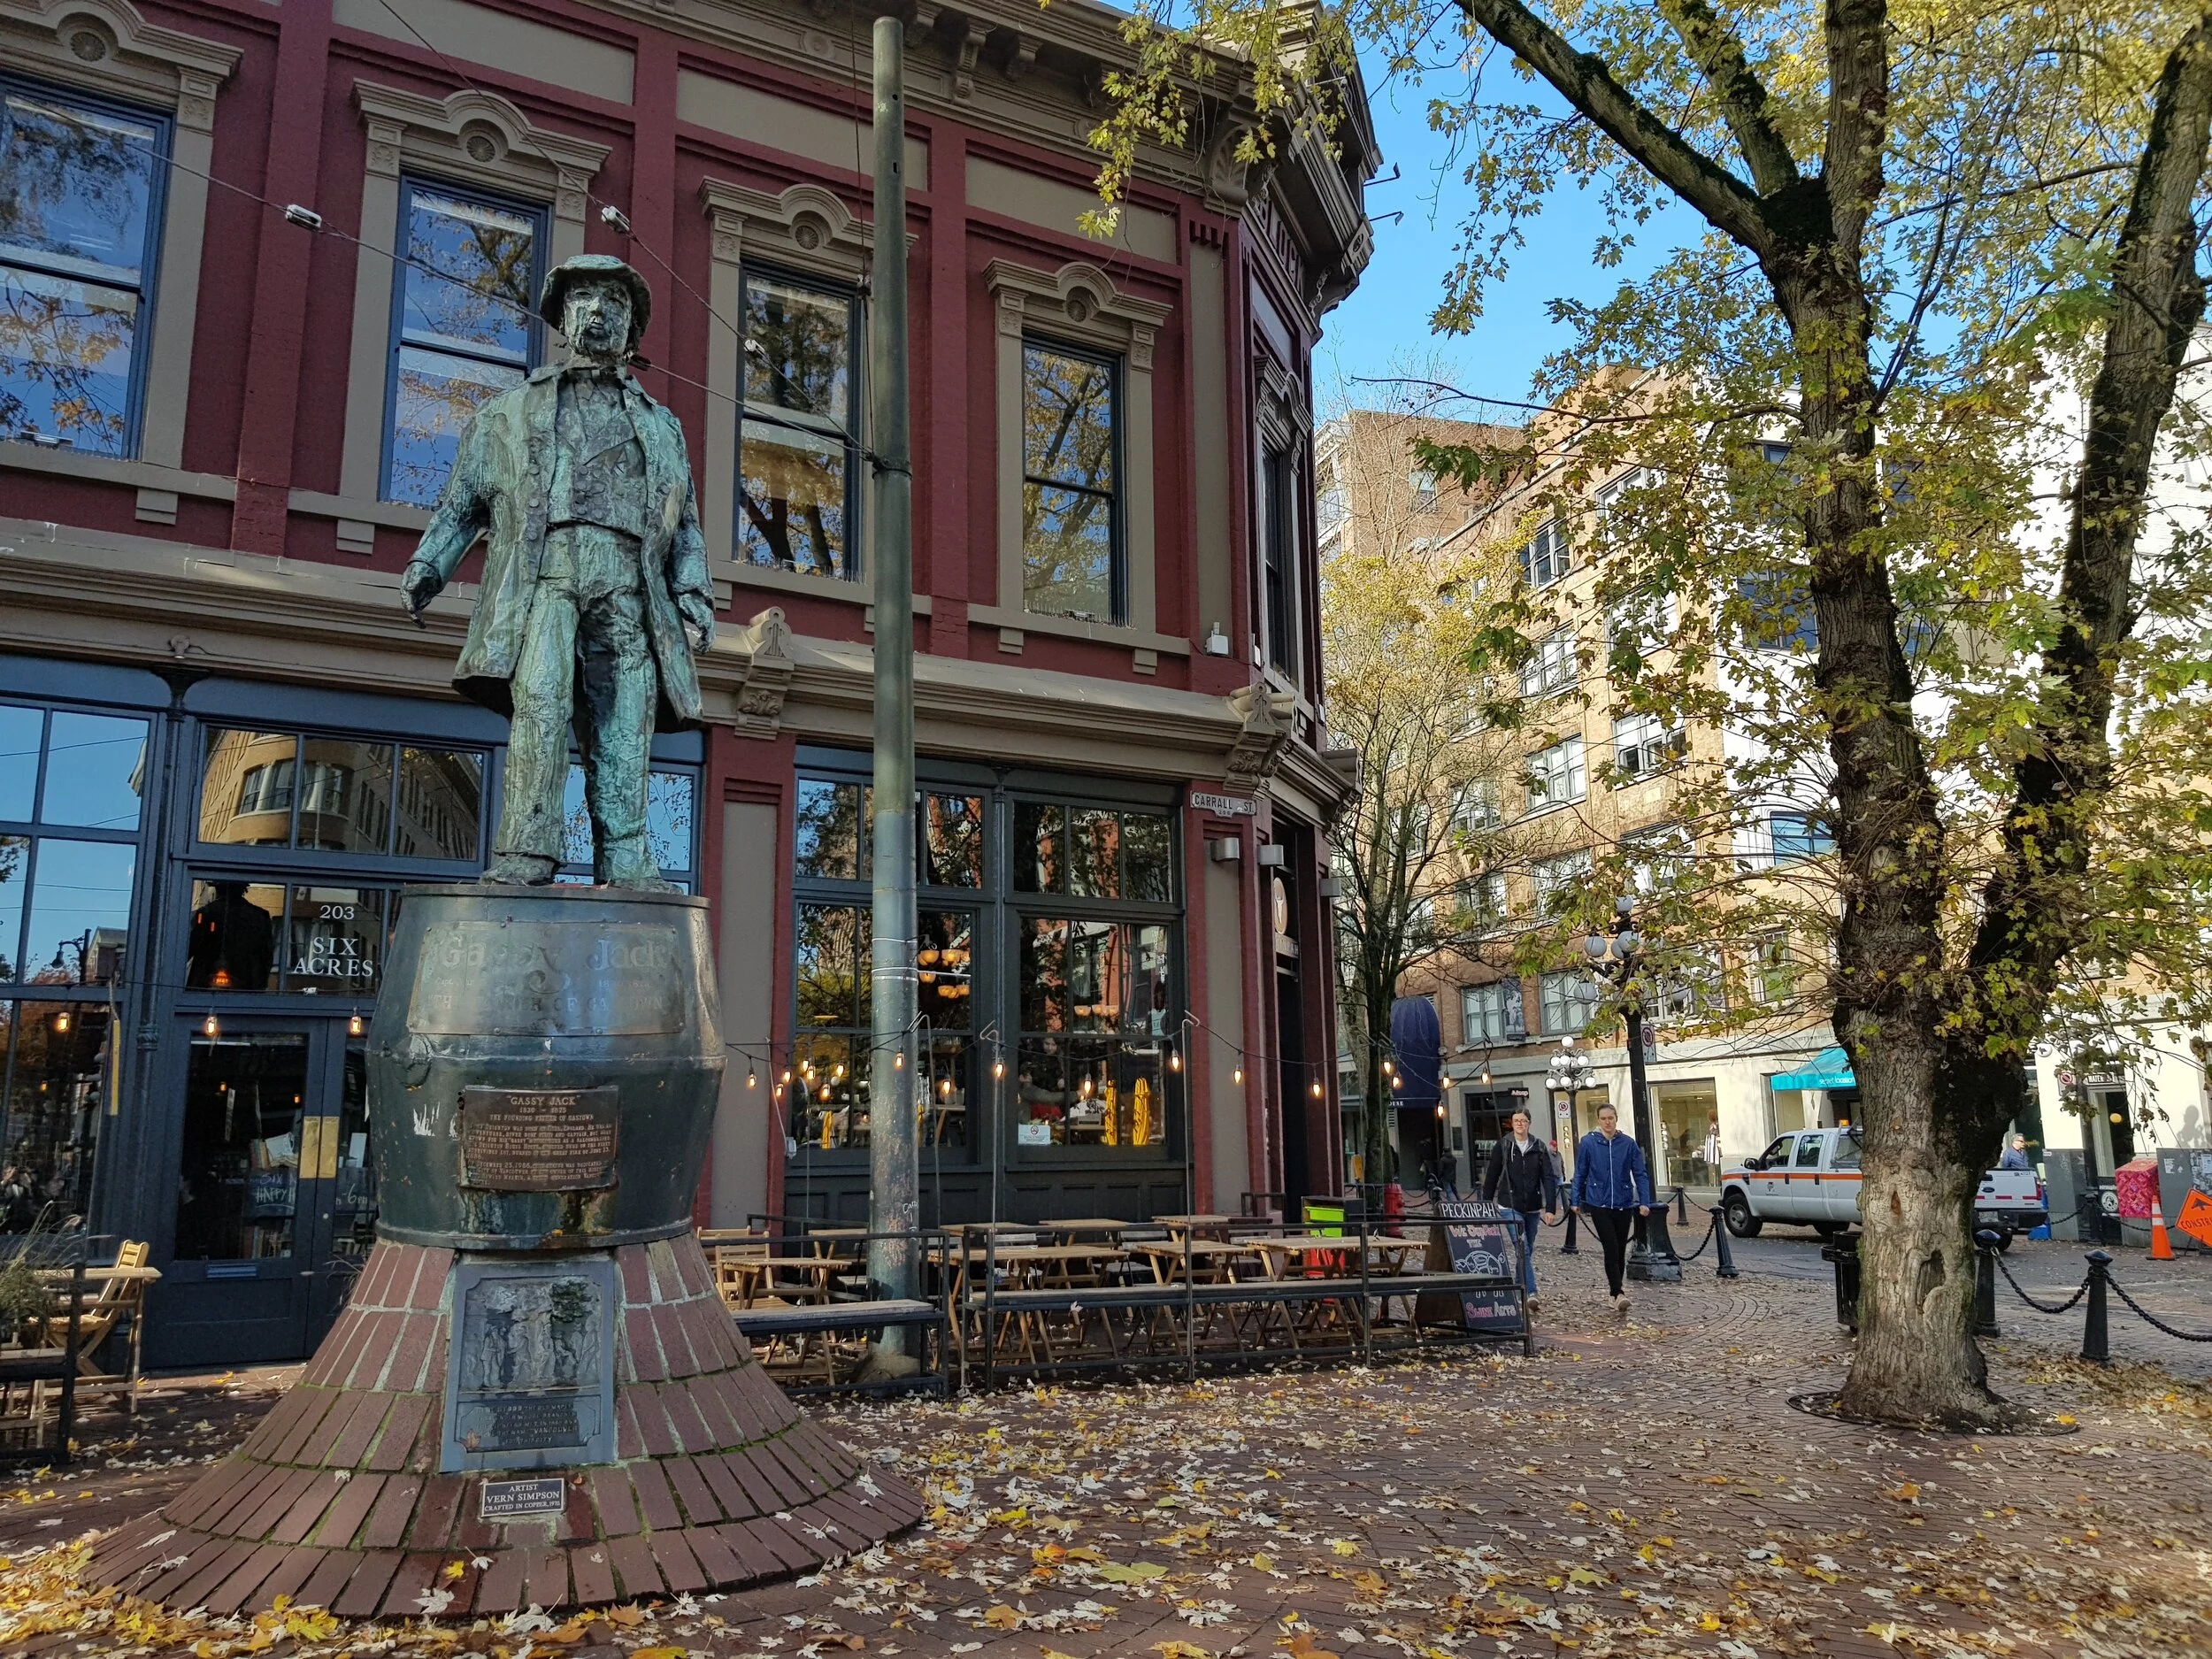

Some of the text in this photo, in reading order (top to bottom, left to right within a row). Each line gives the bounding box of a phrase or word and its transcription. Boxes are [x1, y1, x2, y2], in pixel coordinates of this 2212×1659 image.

[1194, 795, 1233, 810] CARRALL
[319, 905, 355, 920] 203
[312, 937, 359, 956] SIX
[292, 957, 373, 977] ACRES
[1441, 1202, 1496, 1218] PECKINPAH
[487, 1491, 560, 1503] VERN SIMPSON
